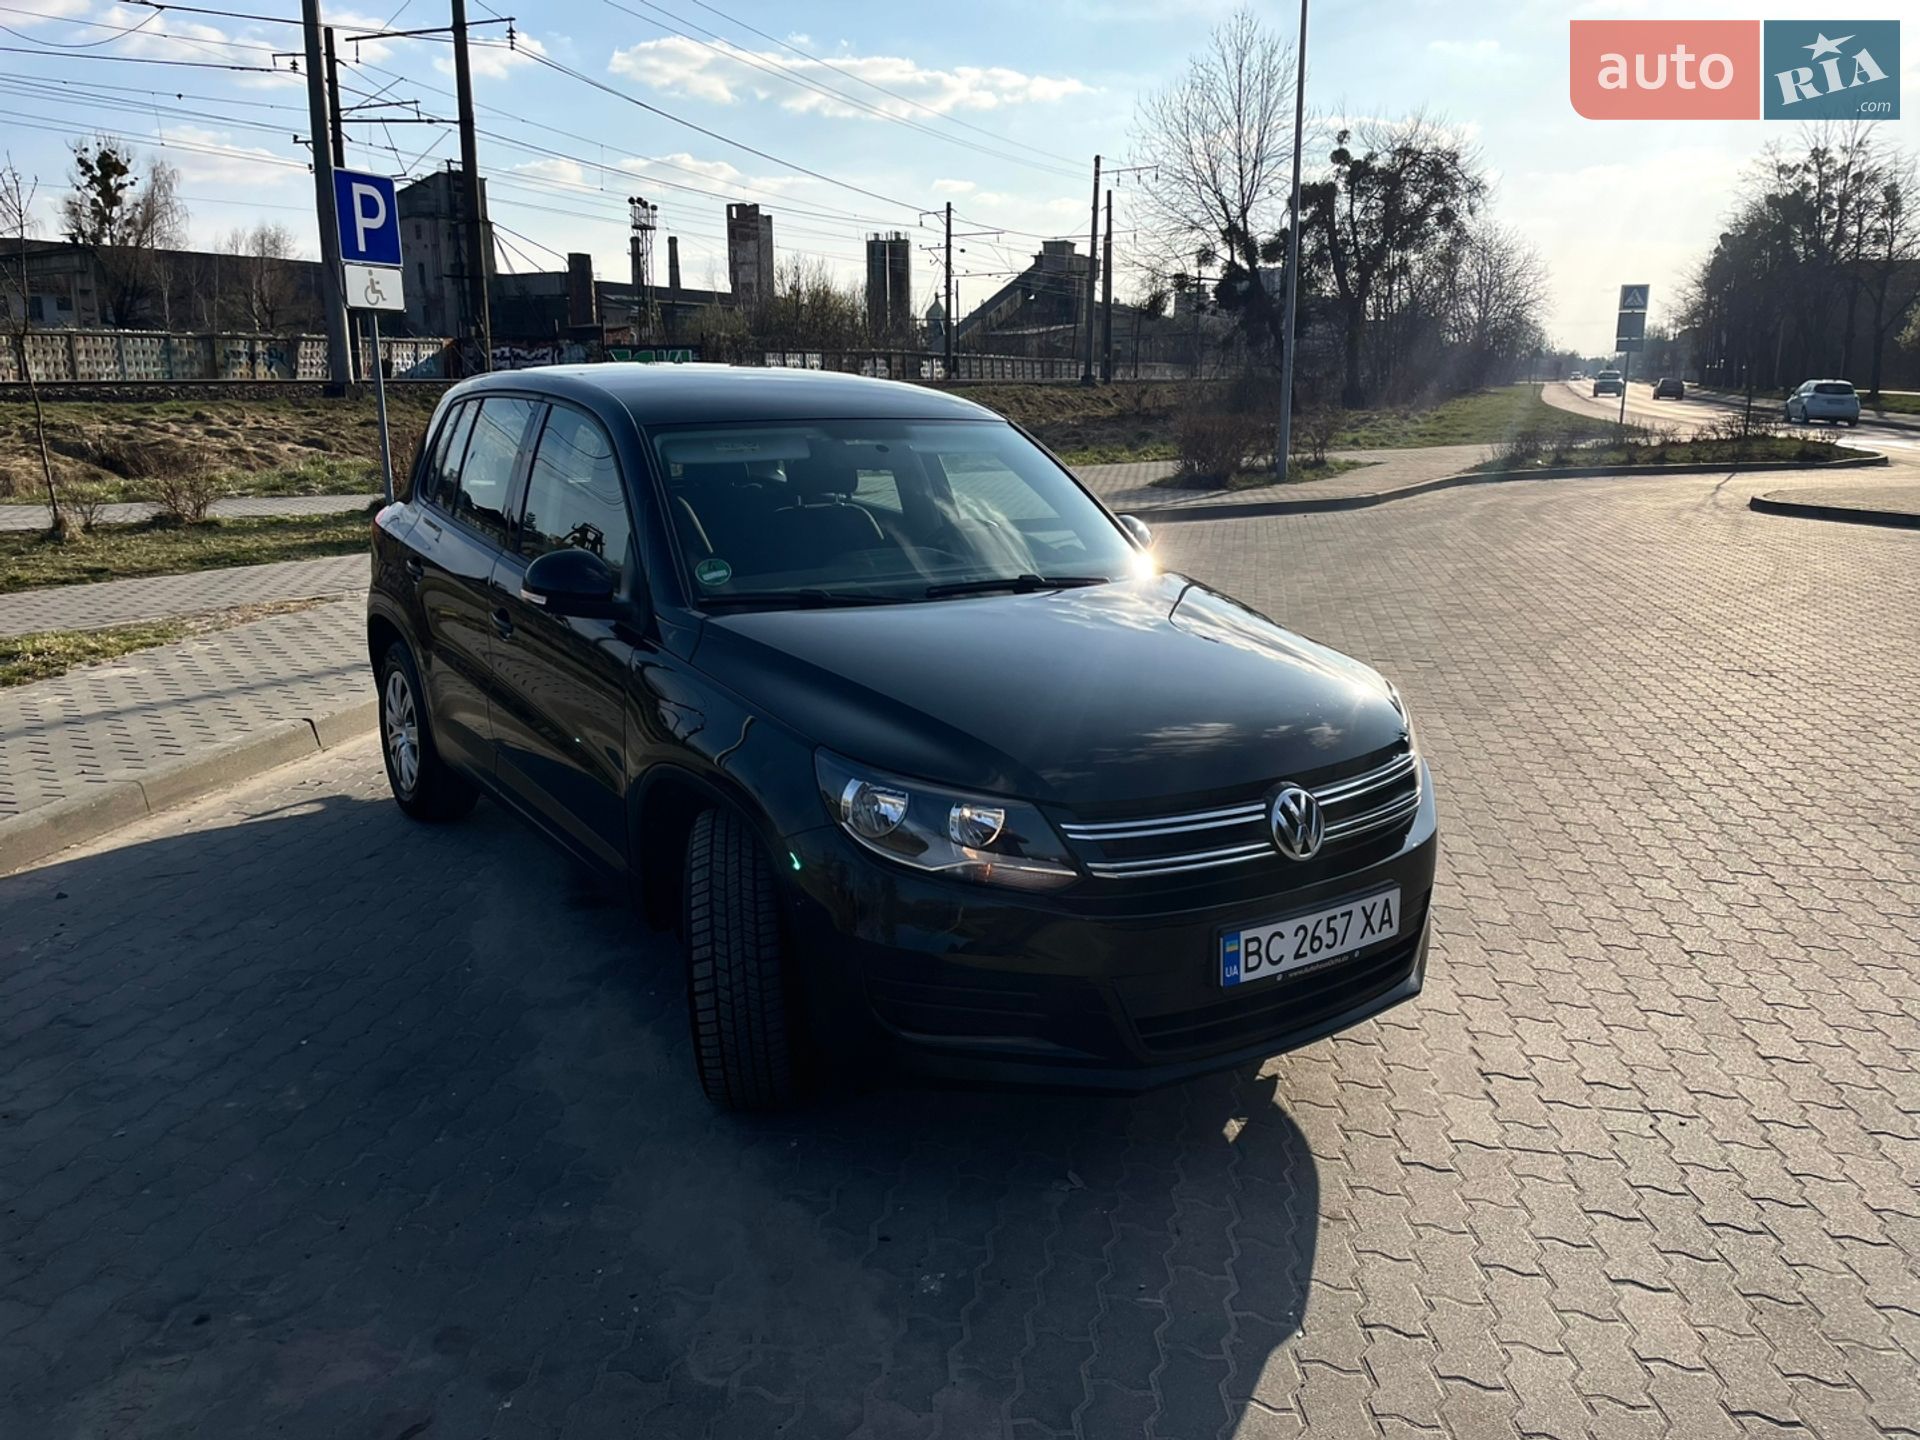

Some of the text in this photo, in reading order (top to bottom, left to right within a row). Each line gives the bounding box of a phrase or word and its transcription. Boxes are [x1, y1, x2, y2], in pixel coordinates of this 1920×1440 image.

[351, 182, 387, 252] P
[1225, 964, 1239, 978] UA
[1244, 931, 1285, 974] BC
[1293, 909, 1353, 961] 2657
[1360, 898, 1393, 939] XA
